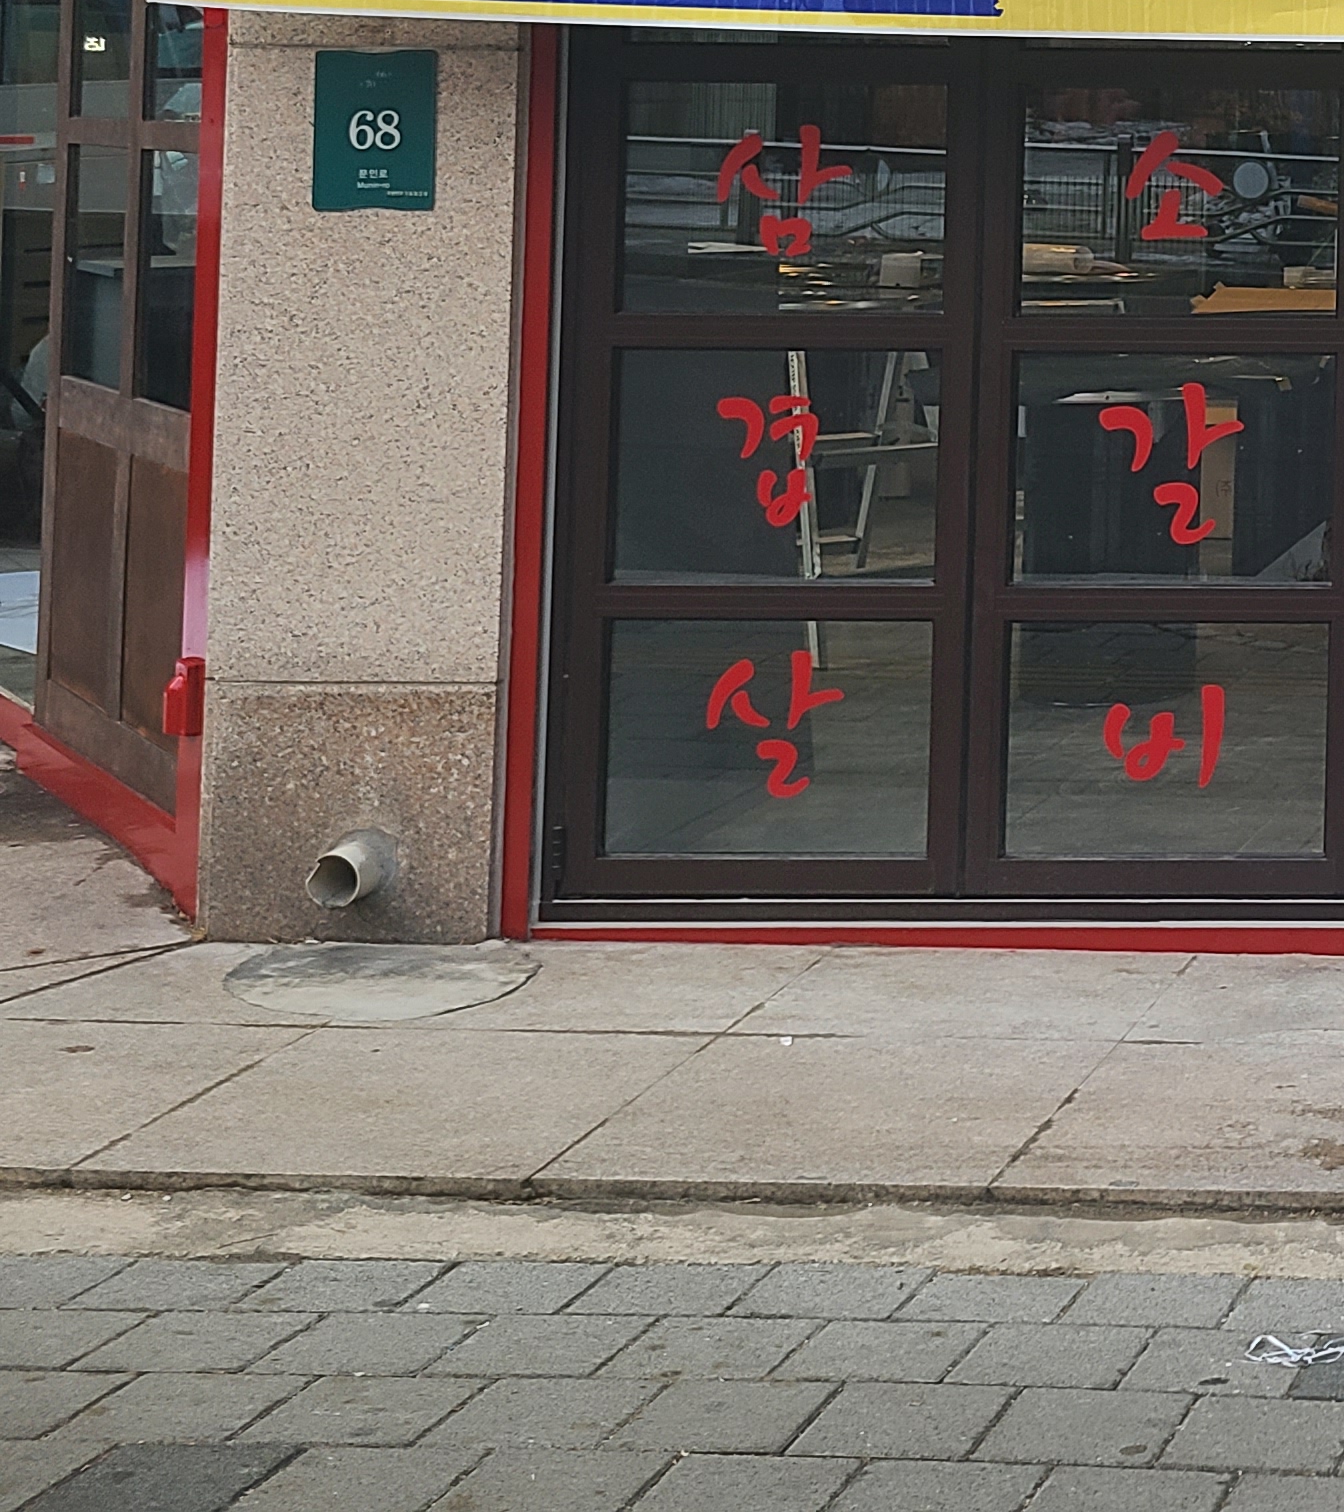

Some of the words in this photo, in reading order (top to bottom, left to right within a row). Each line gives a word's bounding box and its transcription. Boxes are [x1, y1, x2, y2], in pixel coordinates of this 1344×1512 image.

[349, 110, 402, 151] 68
[1098, 130, 1244, 788] 소갈비
[706, 124, 852, 798] 삼겹살
